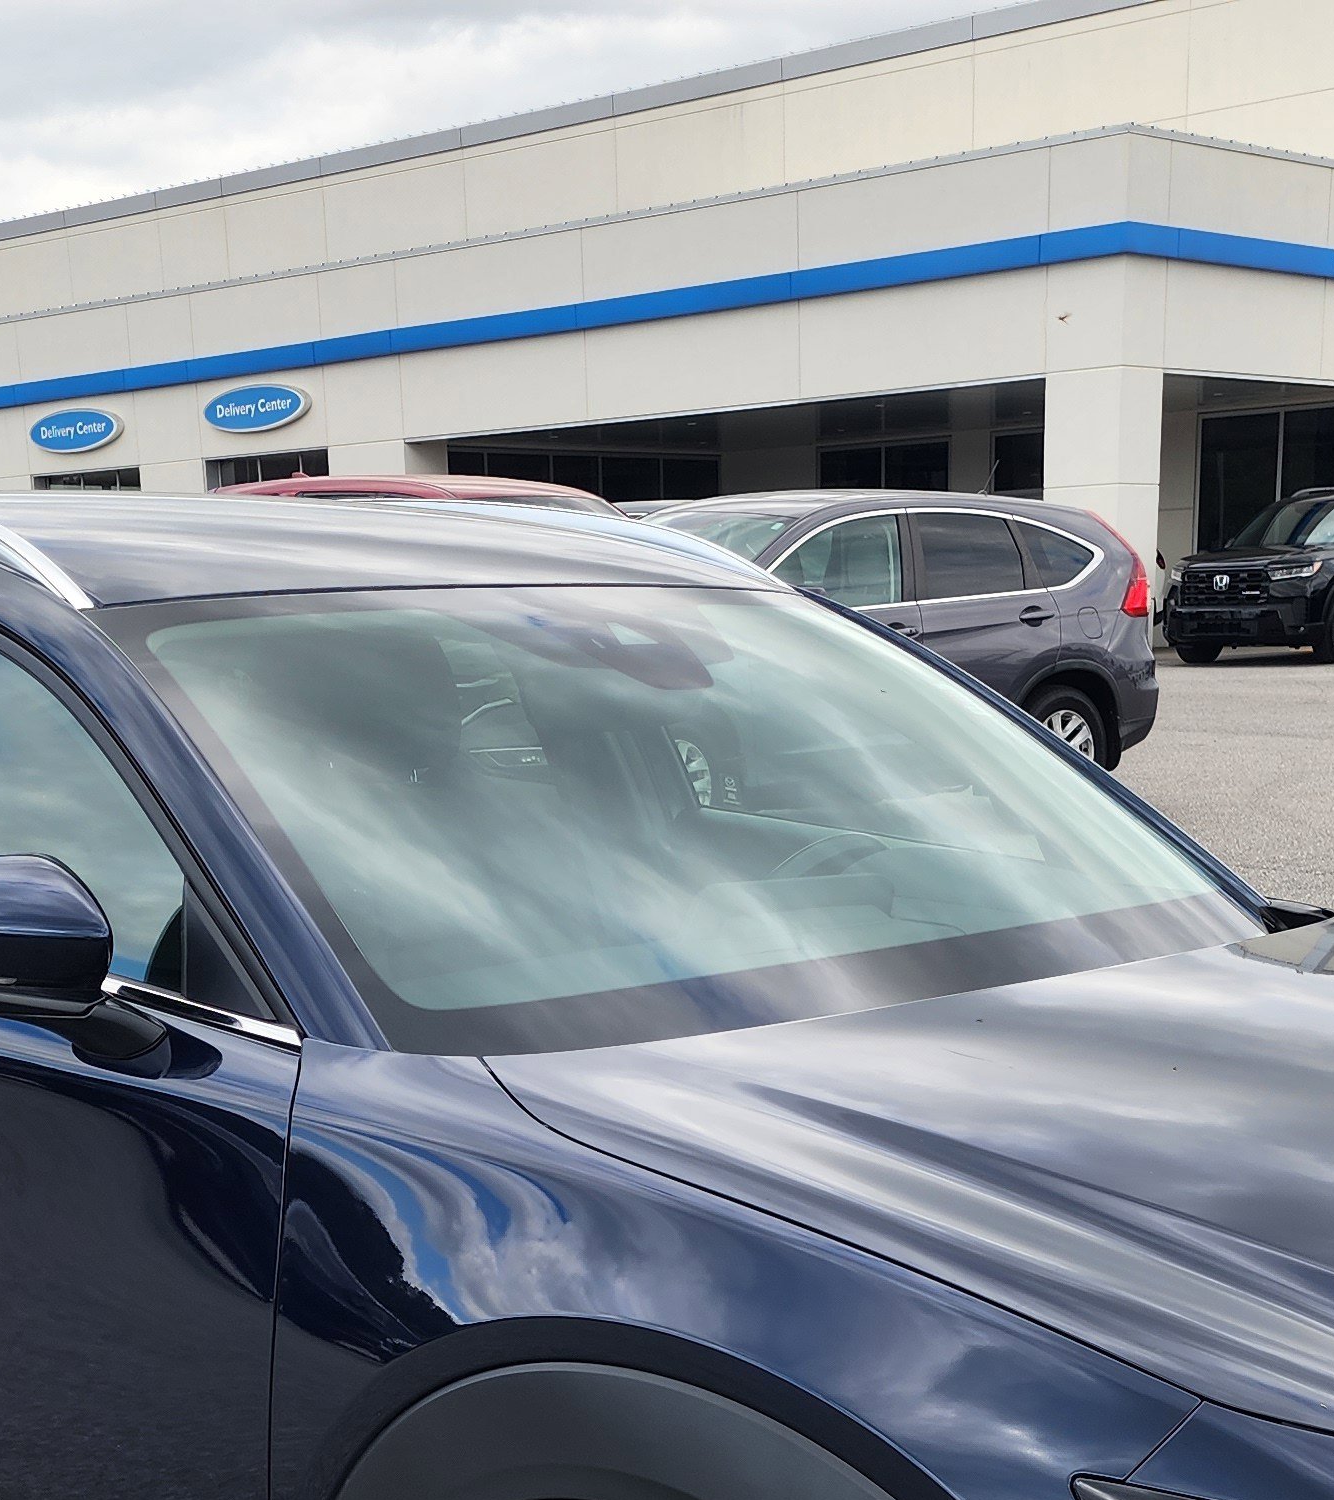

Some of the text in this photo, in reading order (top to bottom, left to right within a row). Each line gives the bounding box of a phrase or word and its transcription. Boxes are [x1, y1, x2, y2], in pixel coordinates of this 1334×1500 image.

[216, 397, 293, 419] Delivery Center
[40, 420, 106, 440] Delivery Center
